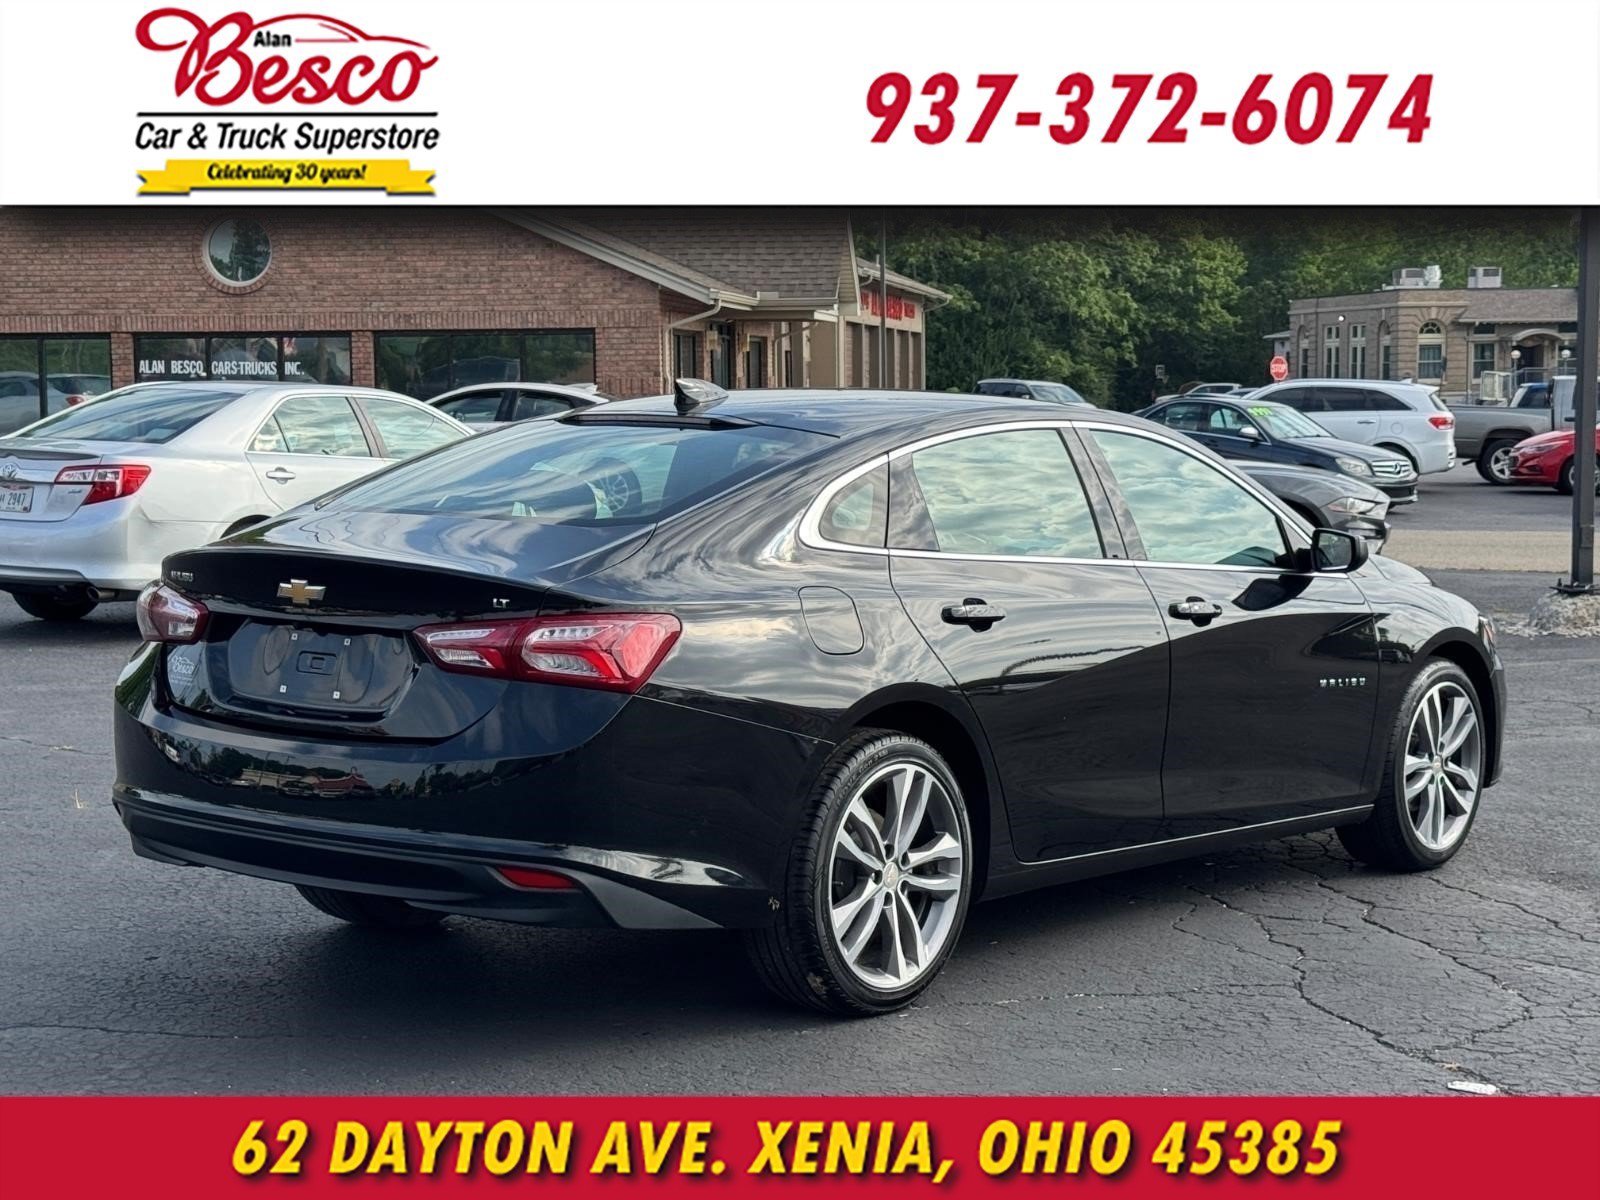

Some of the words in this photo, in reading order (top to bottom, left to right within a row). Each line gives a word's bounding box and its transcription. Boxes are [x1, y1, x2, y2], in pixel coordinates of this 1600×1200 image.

[139, 360, 165, 374] ALAN
[171, 360, 204, 375] BESCO
[284, 361, 305, 376] INC.
[492, 598, 510, 609] LT
[1319, 677, 1366, 688] MALIBU
